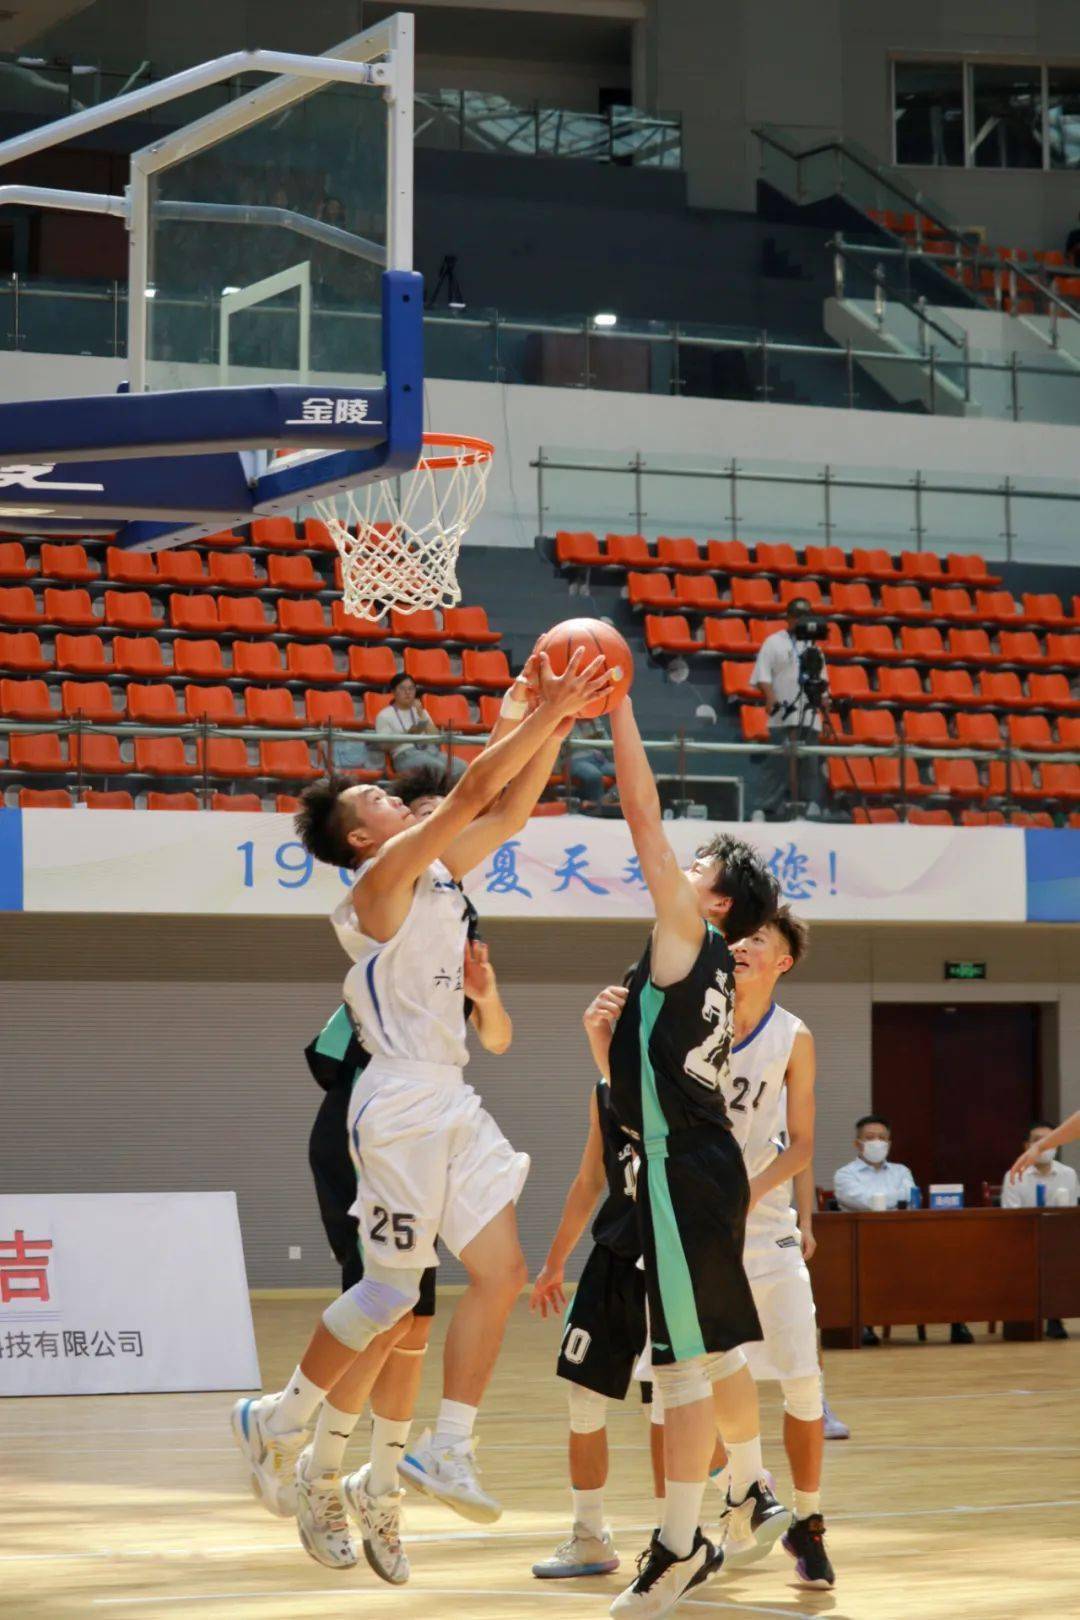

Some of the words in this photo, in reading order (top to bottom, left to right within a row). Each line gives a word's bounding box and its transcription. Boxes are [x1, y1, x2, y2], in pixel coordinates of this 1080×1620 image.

[286, 398, 383, 424] 金陵
[729, 1076, 768, 1112] 21
[370, 1205, 417, 1252] 25
[0, 1230, 53, 1303] 吉
[0, 1330, 144, 1359] 技有限公司
